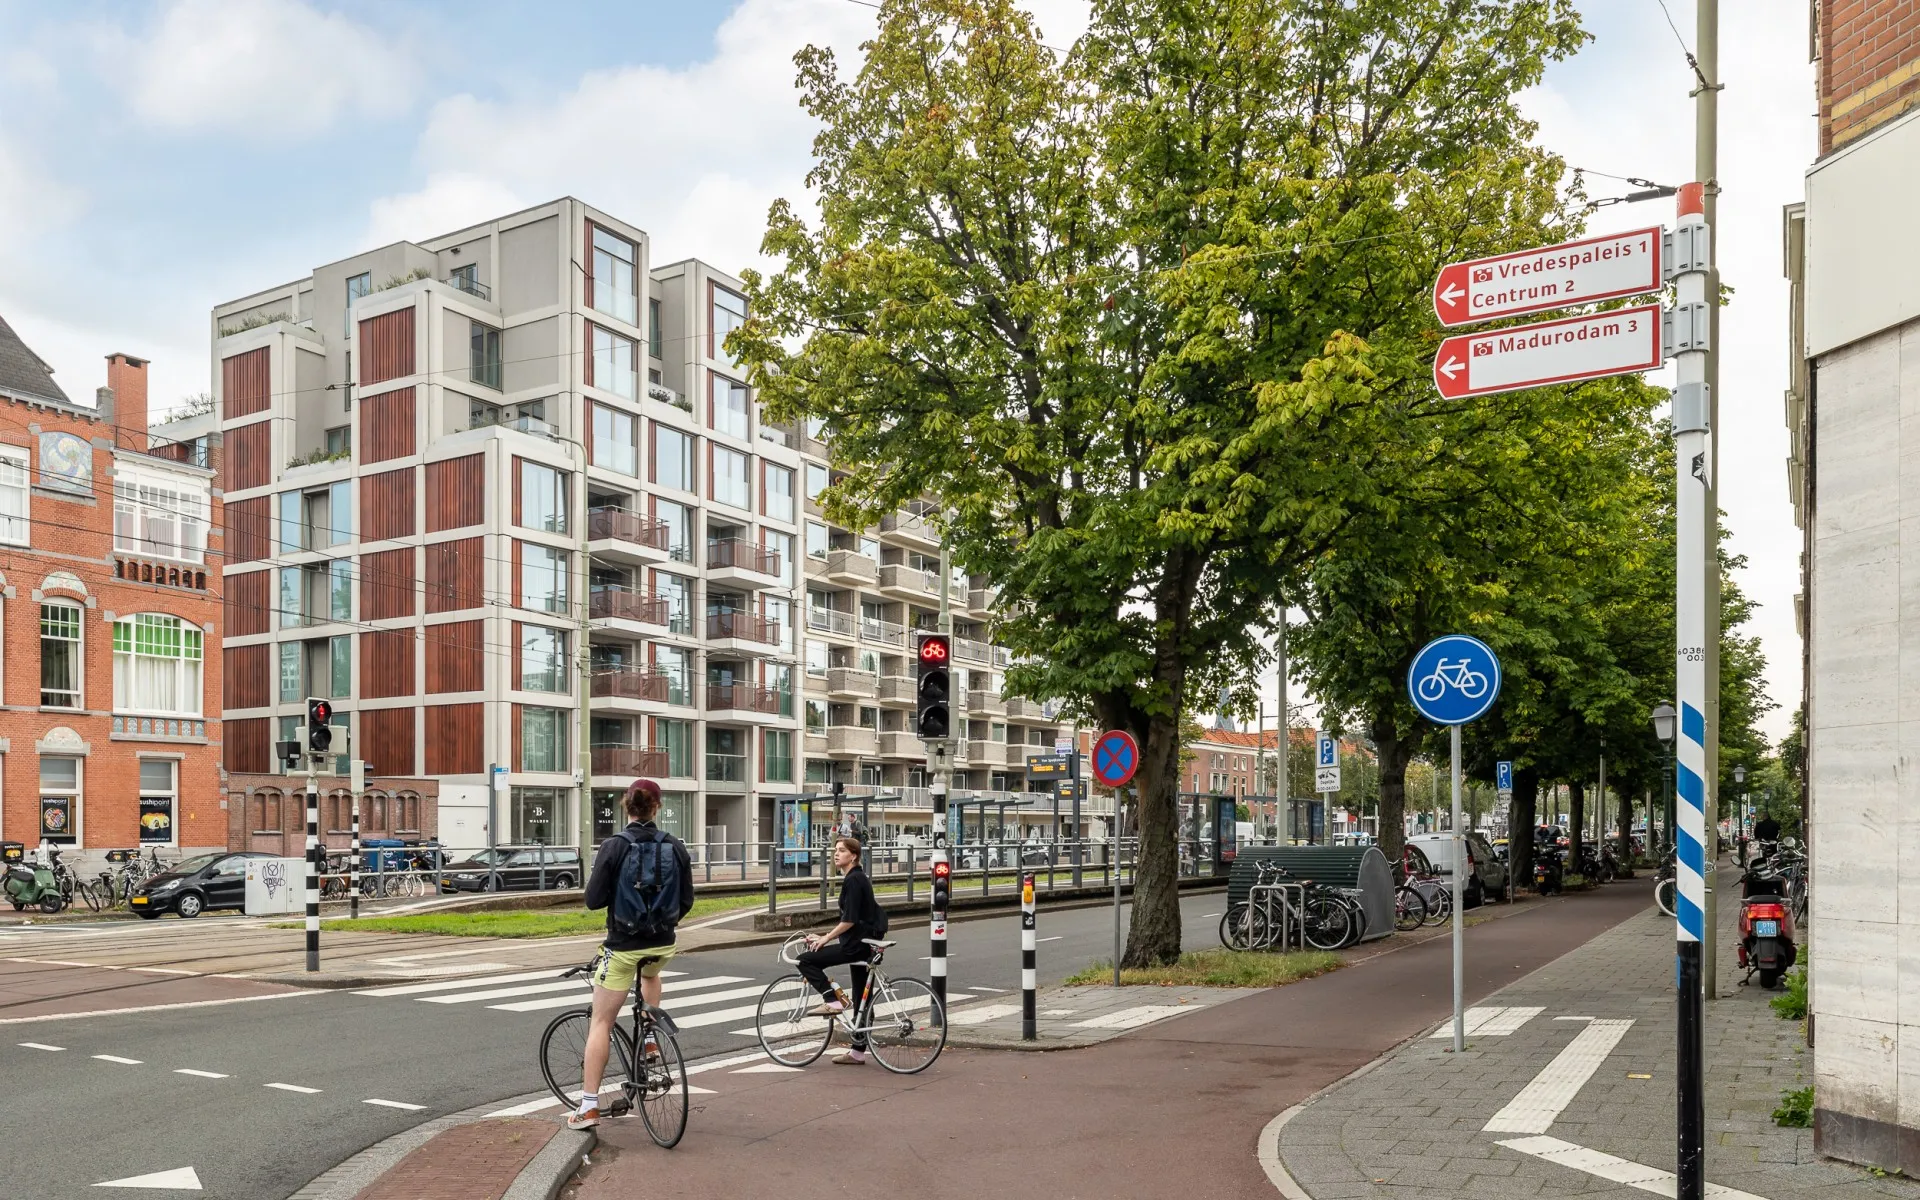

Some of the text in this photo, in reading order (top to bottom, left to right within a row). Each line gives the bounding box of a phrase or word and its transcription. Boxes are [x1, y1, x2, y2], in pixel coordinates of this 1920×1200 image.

[1498, 240, 1647, 279] Vredespaleis 1
[1472, 280, 1575, 308] Centrum 2
[1499, 319, 1638, 353] Madurodam 3
